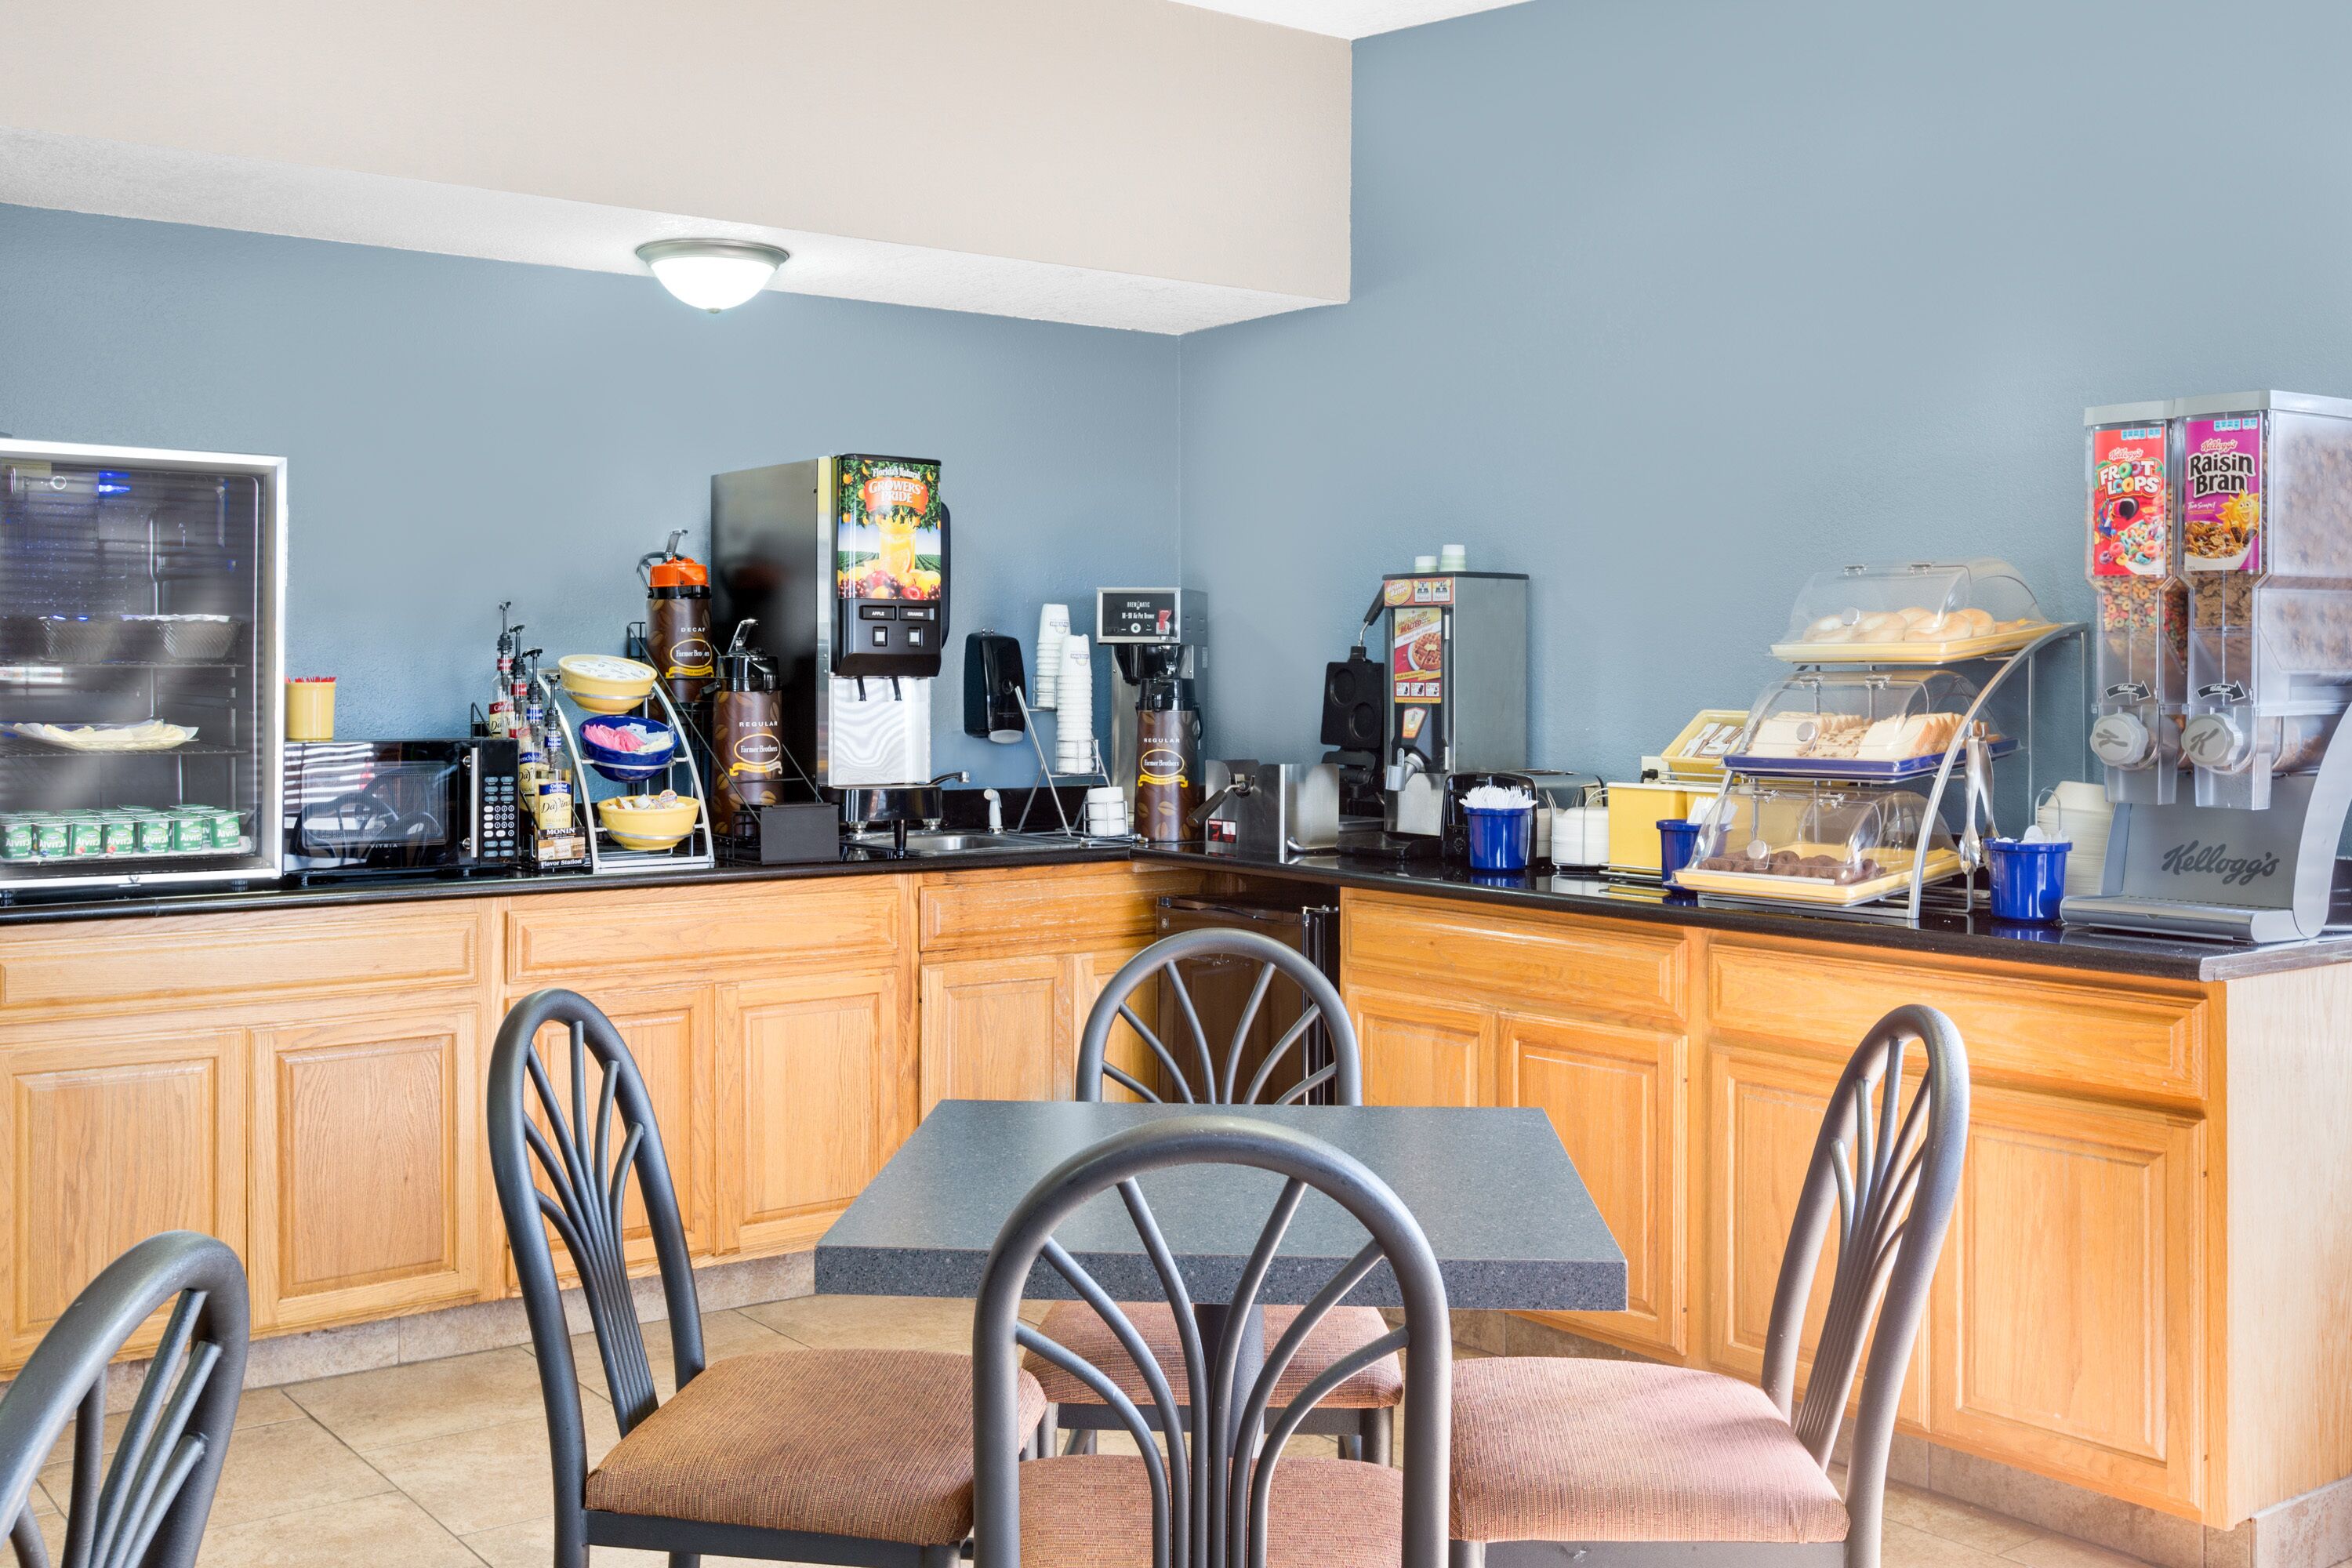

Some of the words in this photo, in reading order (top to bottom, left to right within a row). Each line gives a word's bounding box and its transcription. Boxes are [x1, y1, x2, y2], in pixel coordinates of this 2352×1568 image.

[2100, 460, 2155, 485] FROOT
[2189, 452, 2256, 479] Raisin
[2107, 476, 2160, 495] LOOPS
[2194, 474, 2249, 497] Bran
[880, 491, 913, 503] PRIDE
[676, 649, 693, 658] Farmer
[759, 744, 779, 753] Brothers
[546, 827, 575, 836] MONIN
[2161, 840, 2281, 886] Kellogg's
